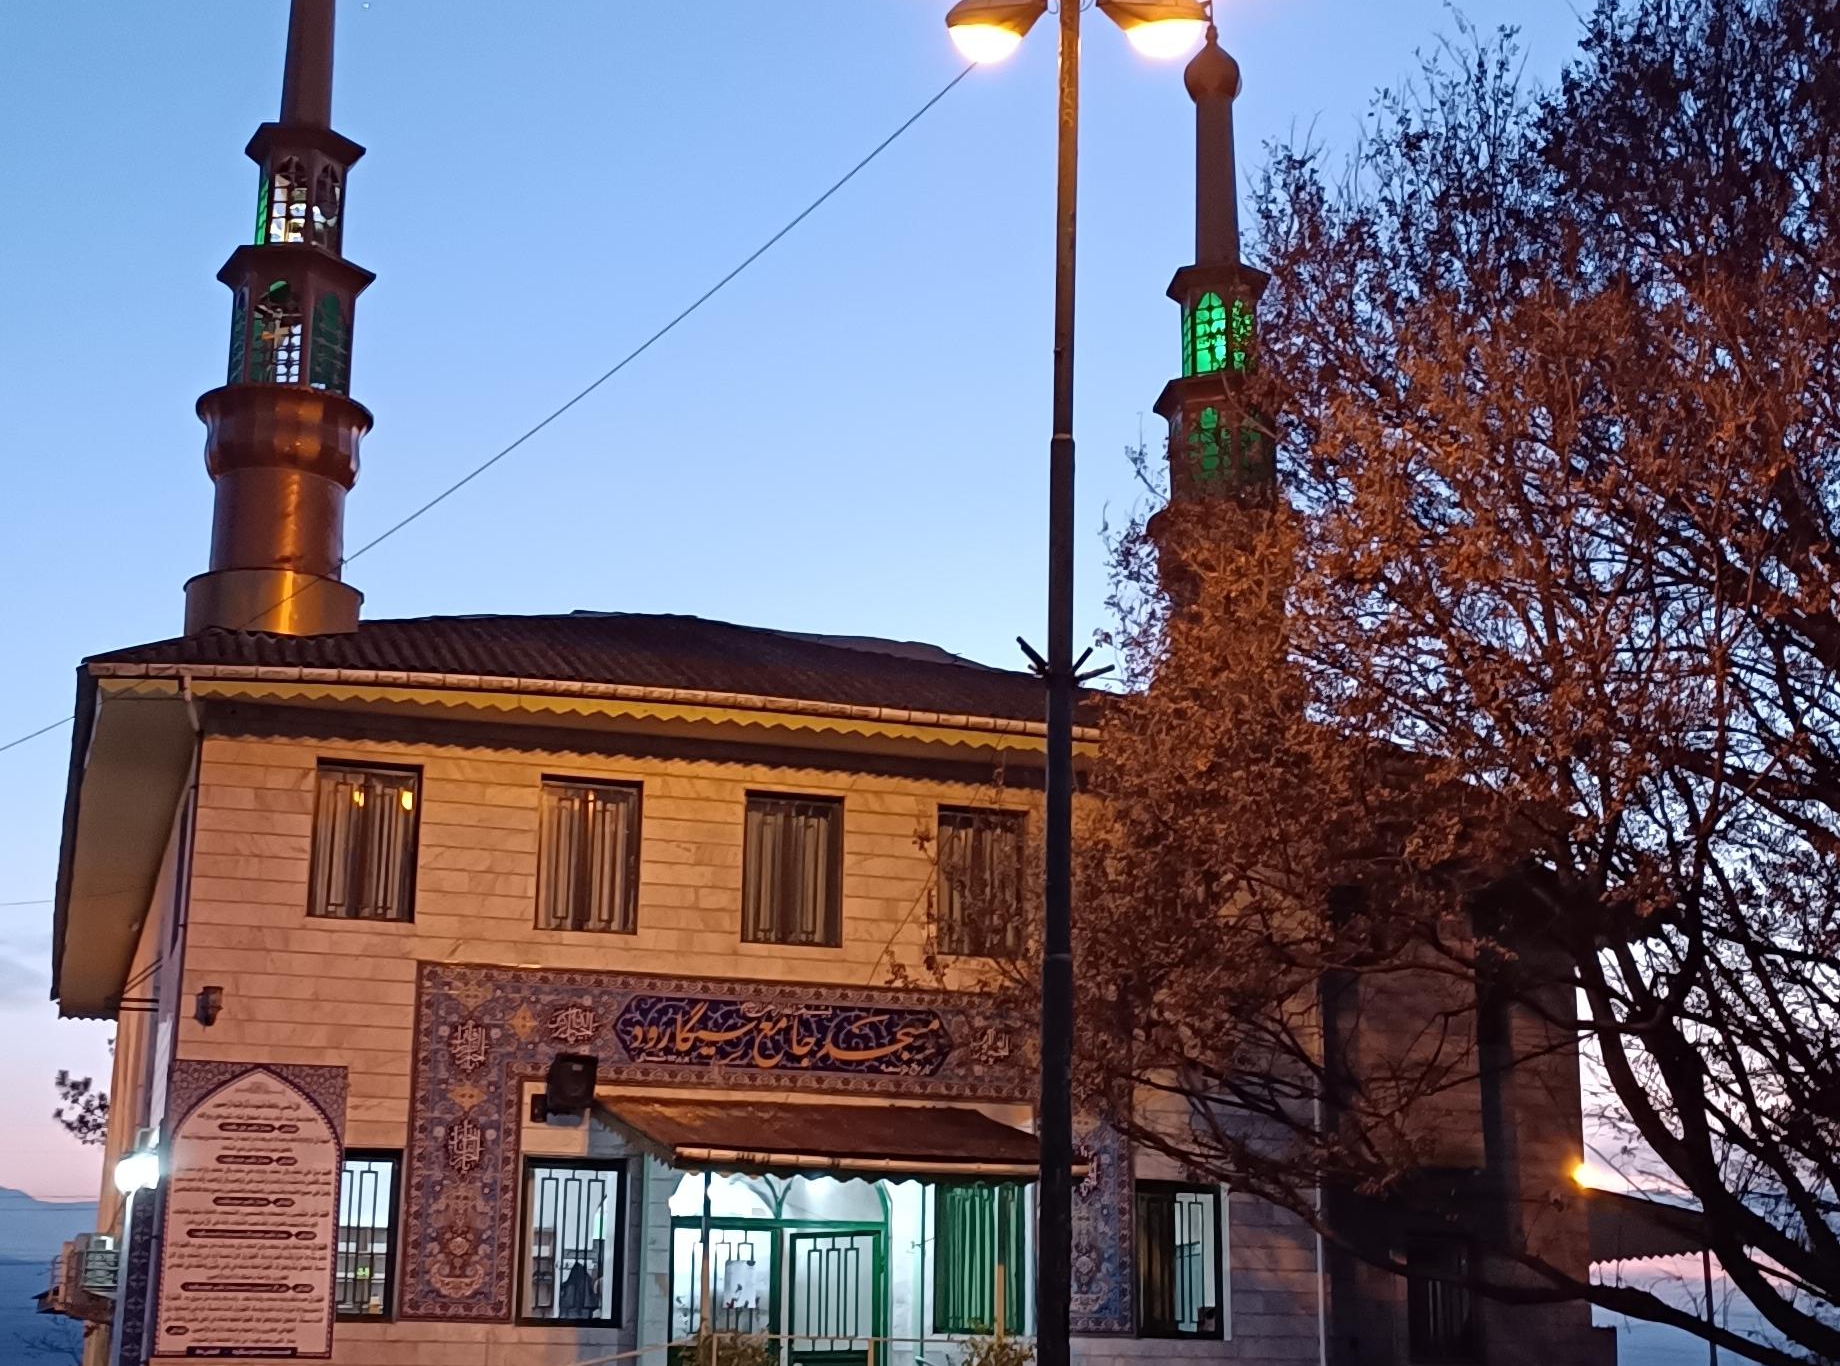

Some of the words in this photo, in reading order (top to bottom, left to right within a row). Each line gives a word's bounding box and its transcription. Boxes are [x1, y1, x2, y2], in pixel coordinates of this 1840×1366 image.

[629, 1001, 758, 1056] سیگارود
[752, 1015, 817, 1068] جامع
[811, 1014, 941, 1063] مسجد
